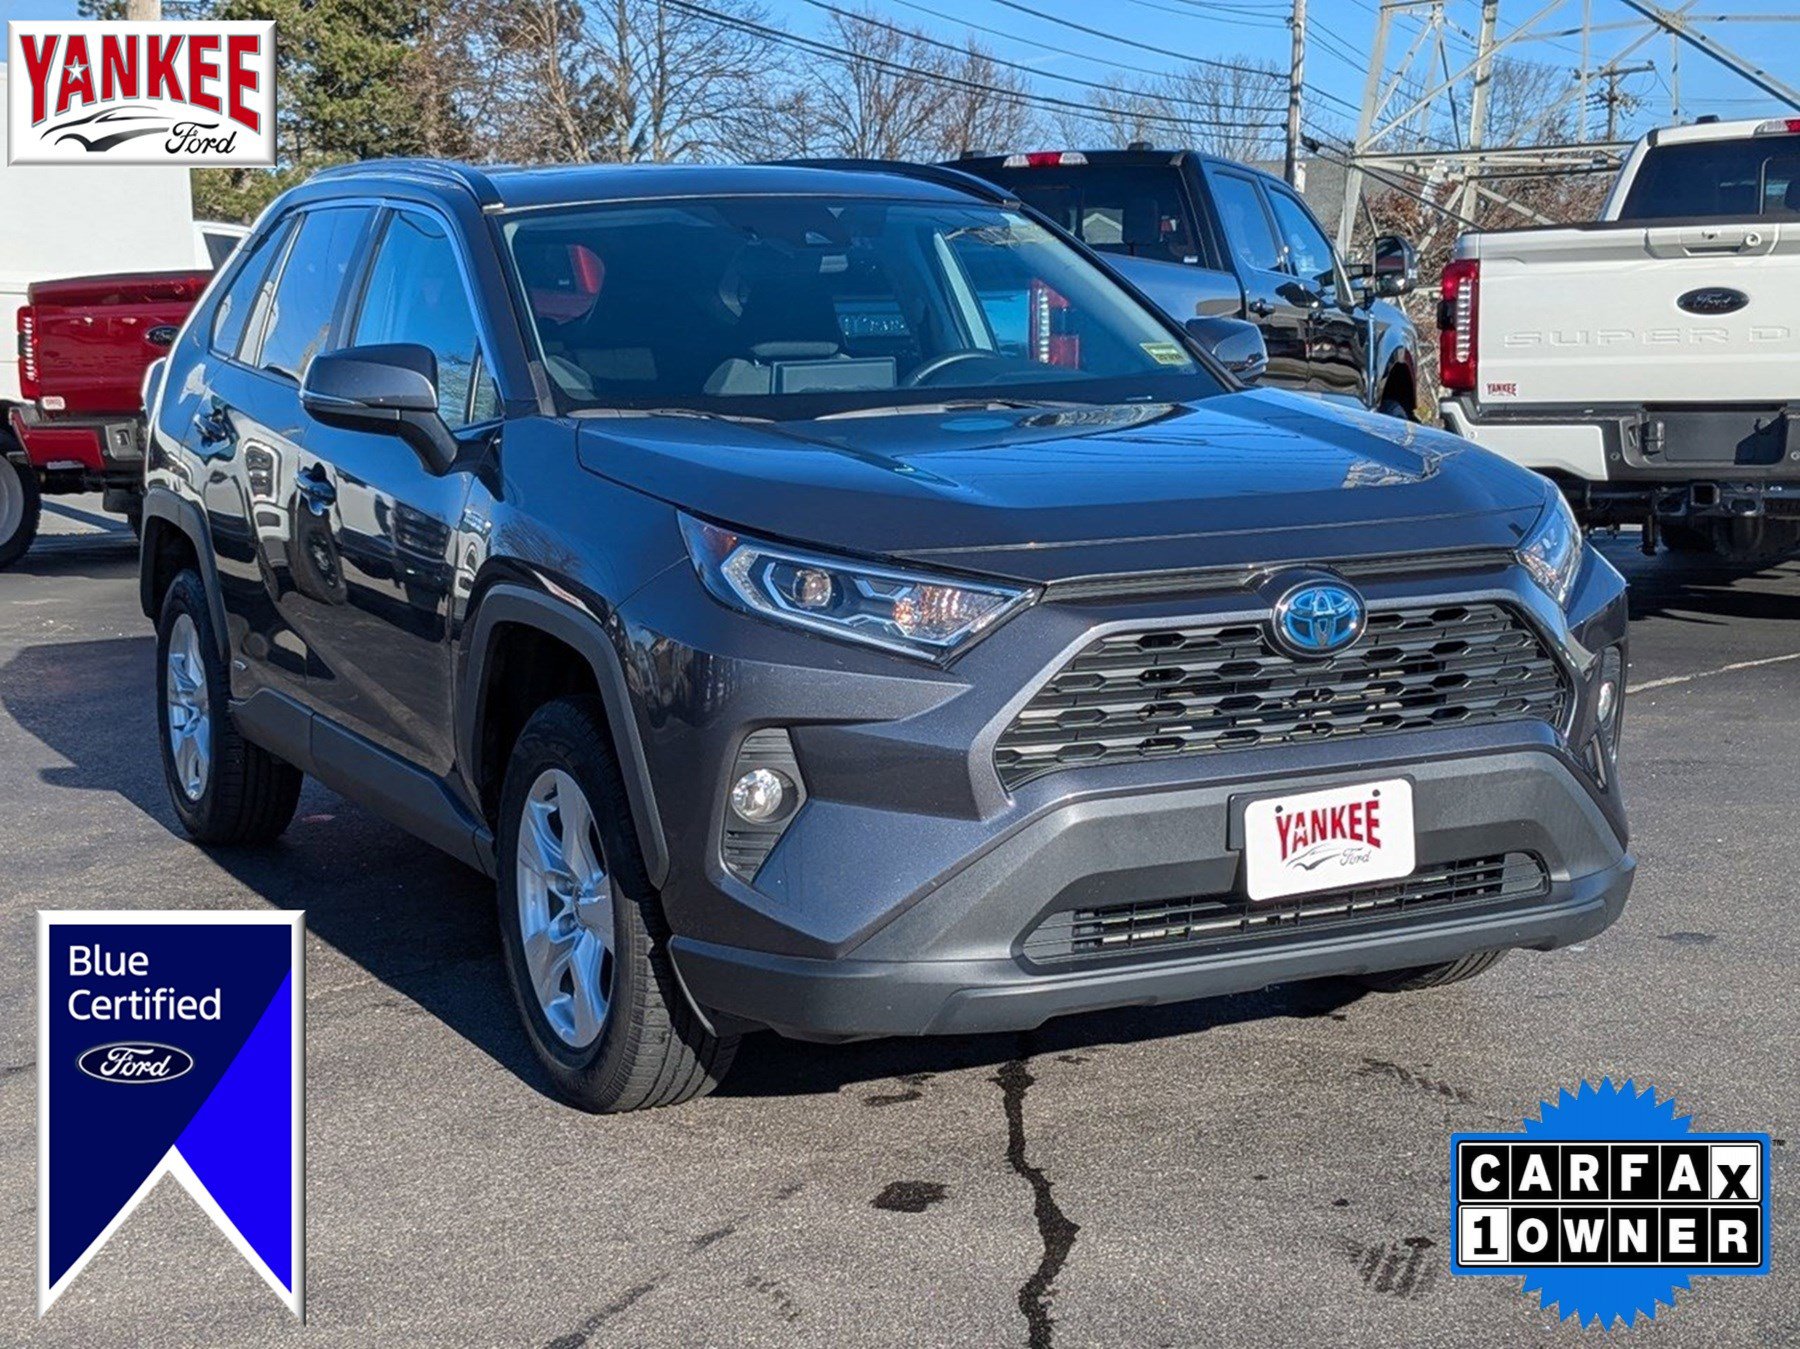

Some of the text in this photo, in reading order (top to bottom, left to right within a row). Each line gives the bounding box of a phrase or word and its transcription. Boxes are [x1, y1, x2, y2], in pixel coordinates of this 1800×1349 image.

[1504, 327, 1730, 348] SUPER
[1275, 799, 1382, 862] YANKEE
[1339, 847, 1372, 867] Ford
